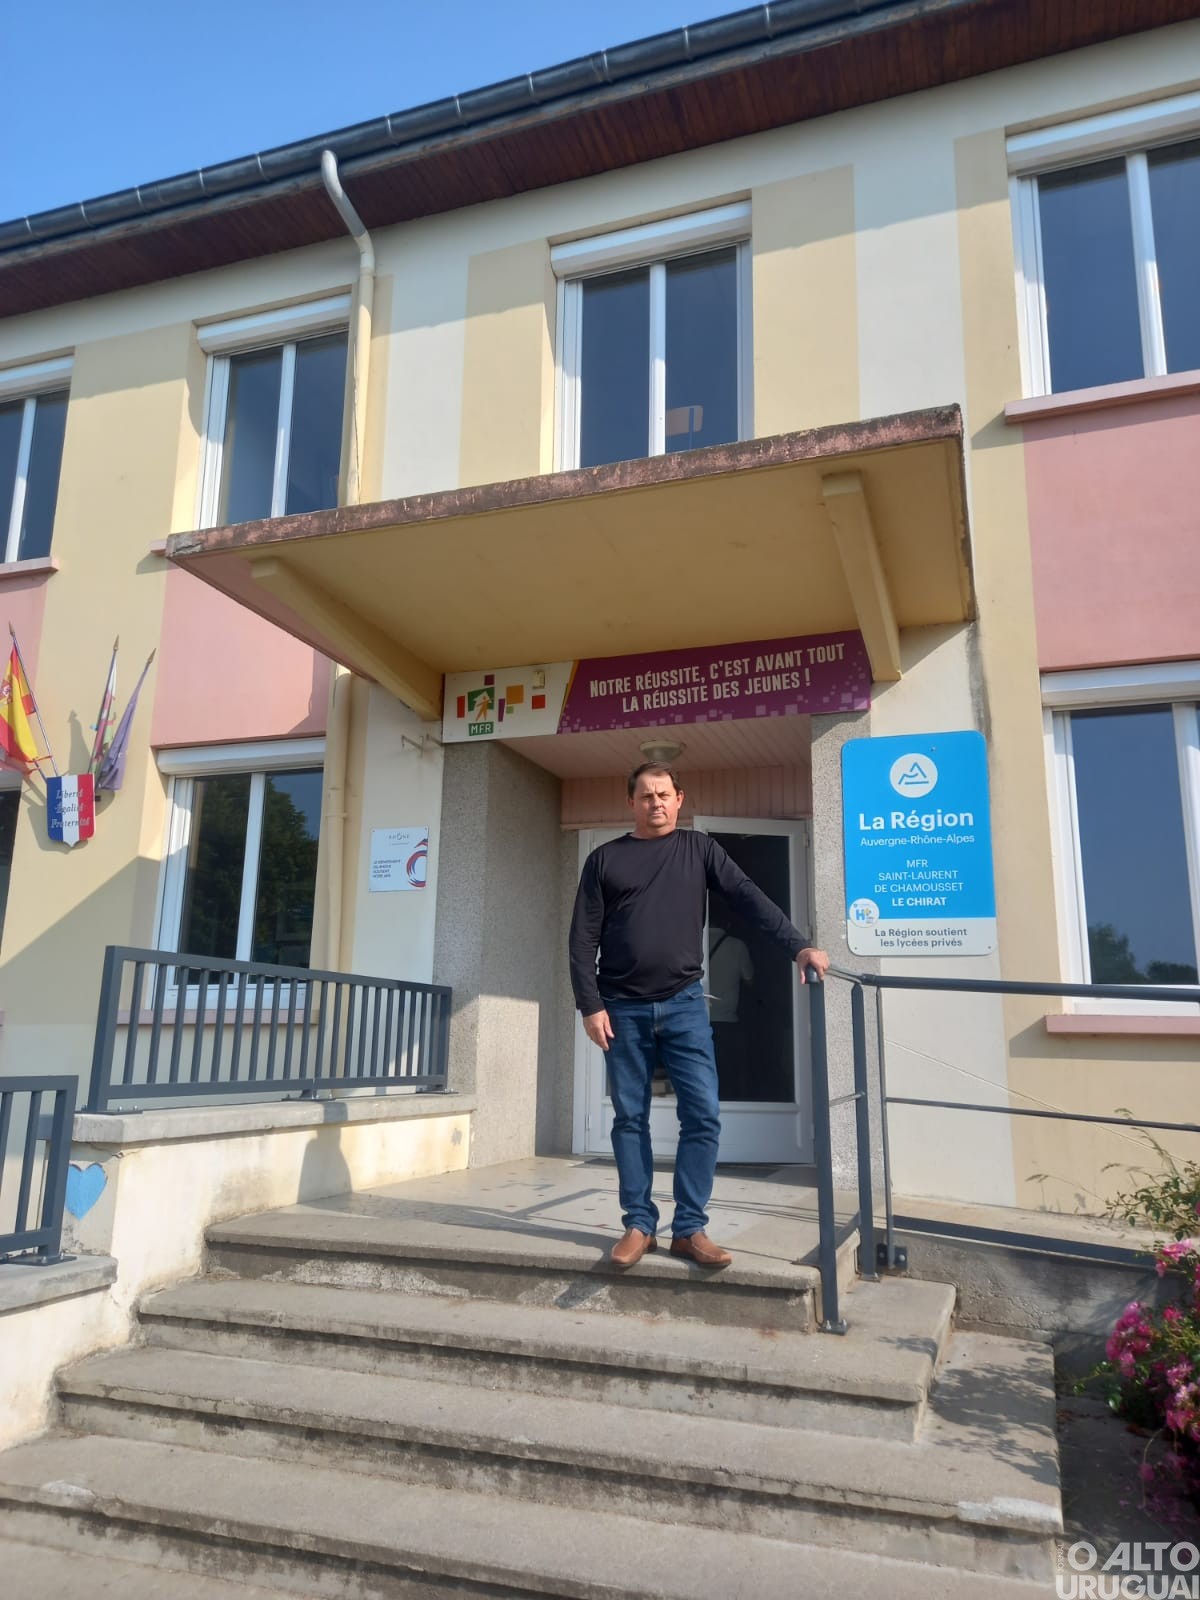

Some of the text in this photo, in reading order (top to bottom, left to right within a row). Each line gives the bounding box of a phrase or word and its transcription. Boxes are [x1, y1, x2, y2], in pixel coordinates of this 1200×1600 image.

[590, 643, 845, 698] NOTRE RÉUSSITE, C'EST AVANT TOUT
[622, 670, 812, 713] LA RÉUSSITE DES JEUNES !
[470, 723, 493, 735] MFR
[859, 809, 974, 831] La Région
[860, 834, 975, 847] Auvergne-Rhône-Alpes
[906, 859, 929, 868] MFR
[878, 871, 958, 881] SAINT-LAURENT
[874, 883, 964, 893] DE CHAMOUSSET
[892, 897, 947, 907] LE CHIRAT
[875, 927, 968, 938] La Région soutient
[880, 938, 963, 949] les lycées privés
